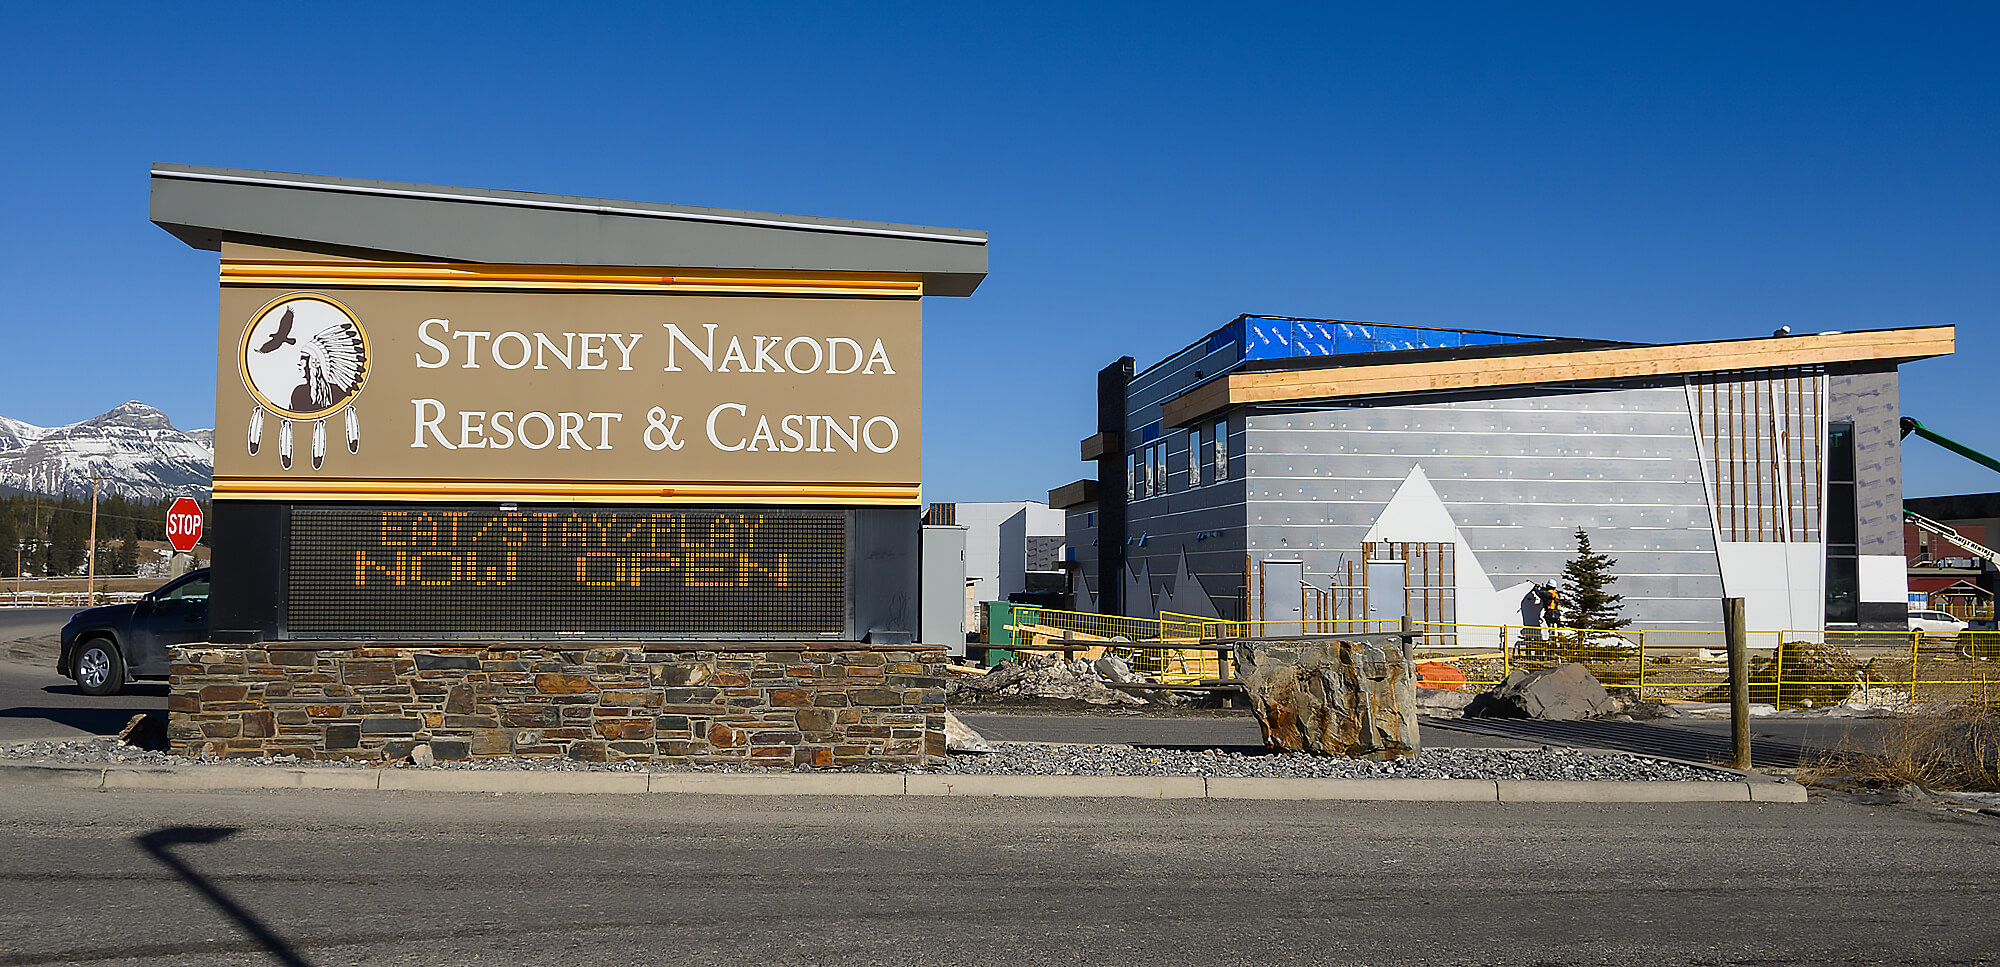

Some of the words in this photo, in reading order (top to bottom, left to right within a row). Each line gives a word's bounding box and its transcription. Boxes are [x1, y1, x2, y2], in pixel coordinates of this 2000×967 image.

[415, 317, 643, 371] STONEY
[663, 323, 897, 375] NAKODA
[410, 398, 623, 451] RESORT
[643, 405, 685, 451] &
[706, 402, 899, 454] CASINO
[168, 513, 201, 535] STOP
[355, 550, 518, 586] NOW
[576, 552, 788, 587] OPEN
